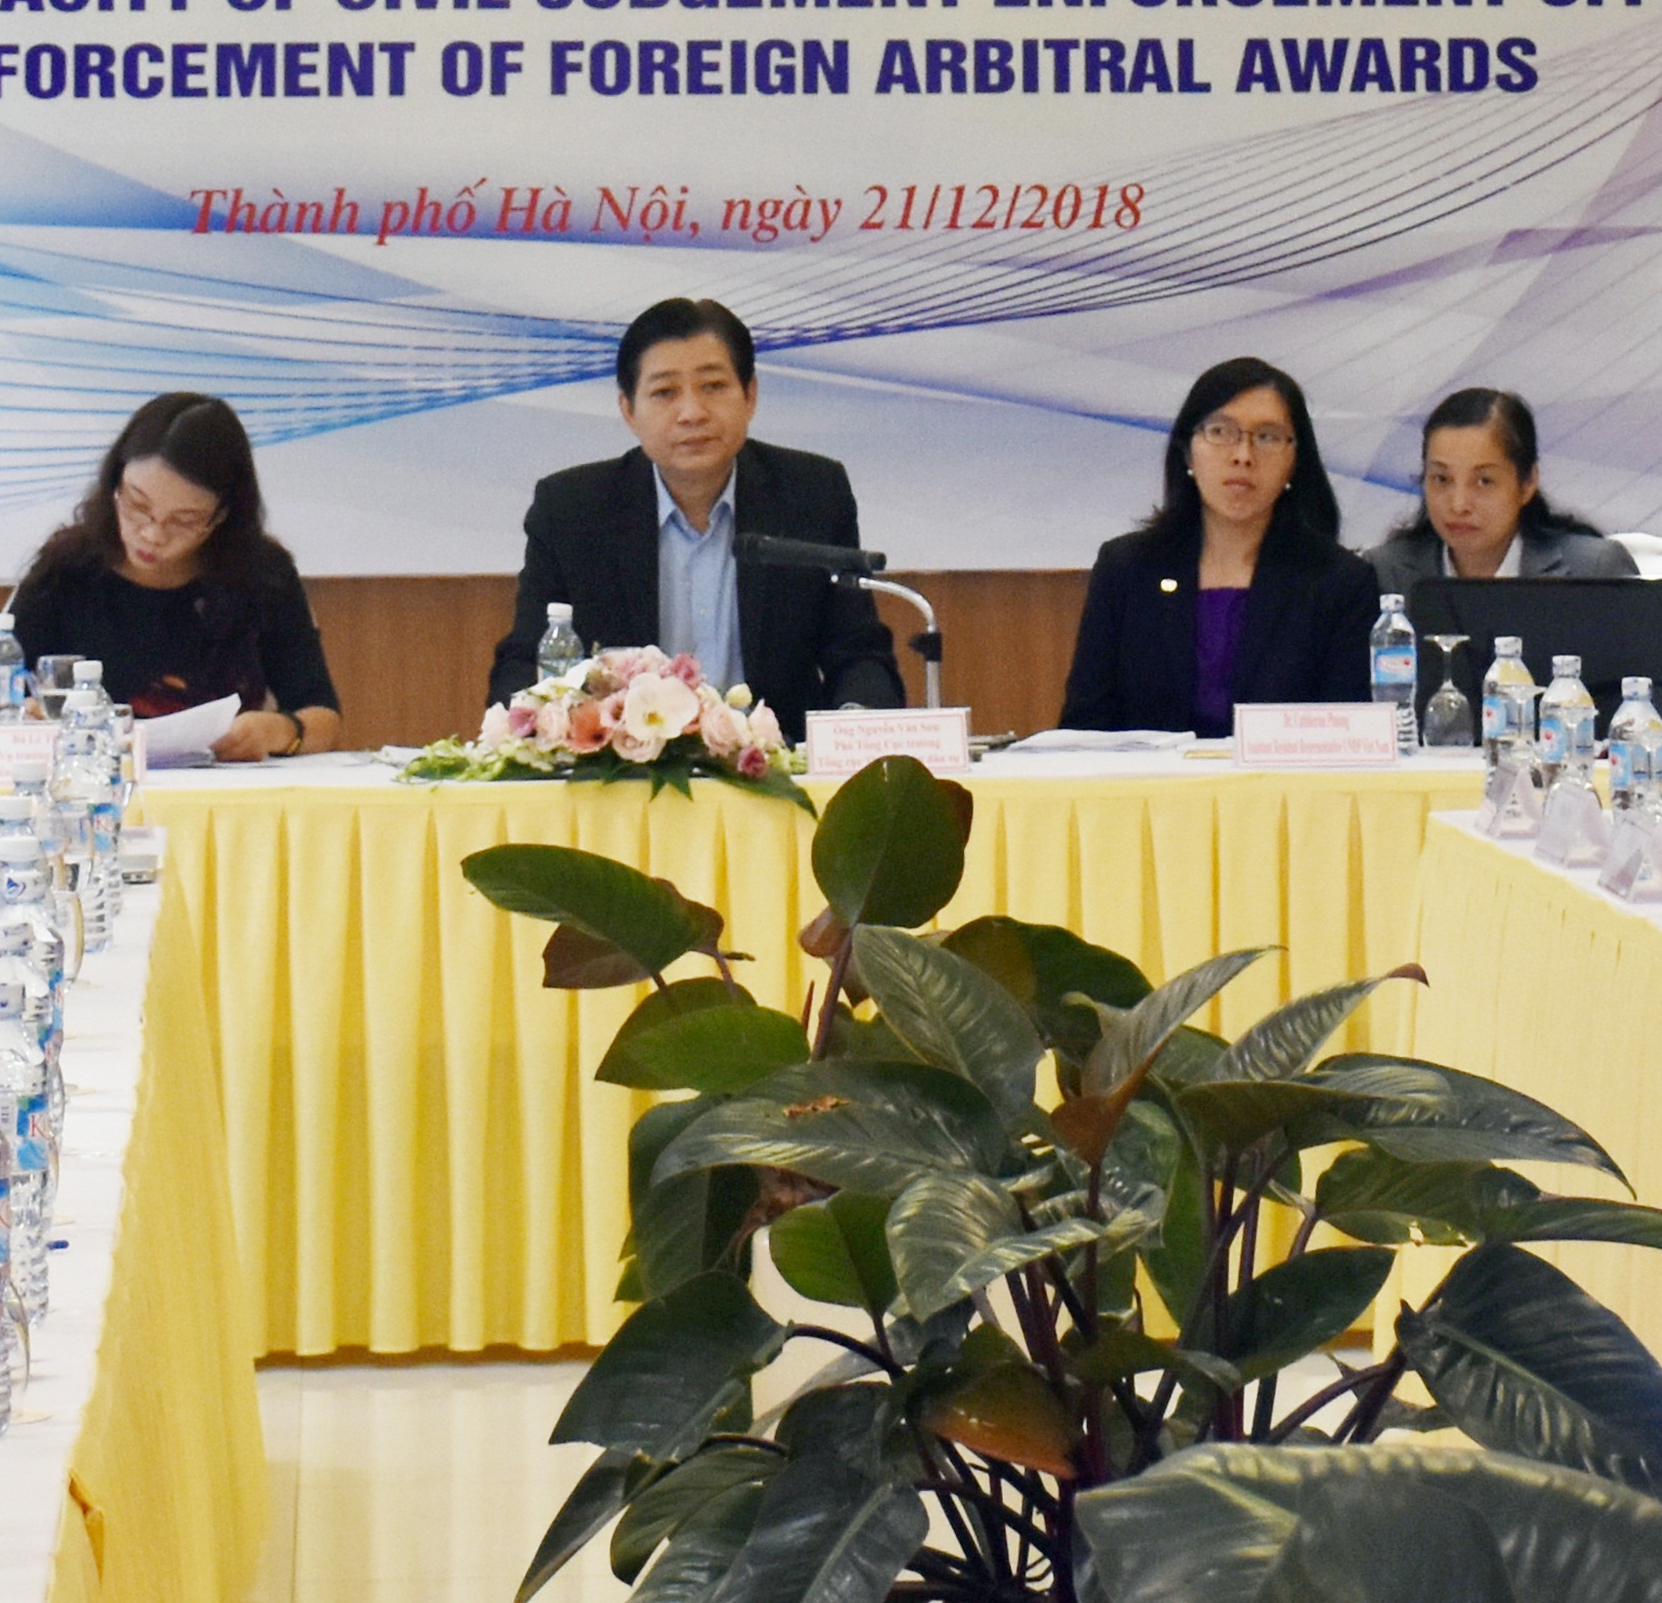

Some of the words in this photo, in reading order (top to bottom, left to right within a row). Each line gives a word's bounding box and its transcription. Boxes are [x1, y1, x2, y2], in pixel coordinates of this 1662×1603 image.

[442, 41, 524, 96] OF
[551, 40, 848, 95] FOREIGN
[875, 39, 1211, 94] ARBITRAL
[1235, 37, 1539, 93] AWARDS
[189, 187, 359, 235] Thành
[376, 177, 488, 246] phố
[494, 186, 572, 234] Hà
[591, 185, 700, 243] Nội,
[721, 185, 843, 243] ngày
[859, 183, 1146, 231] 21/12/2018
